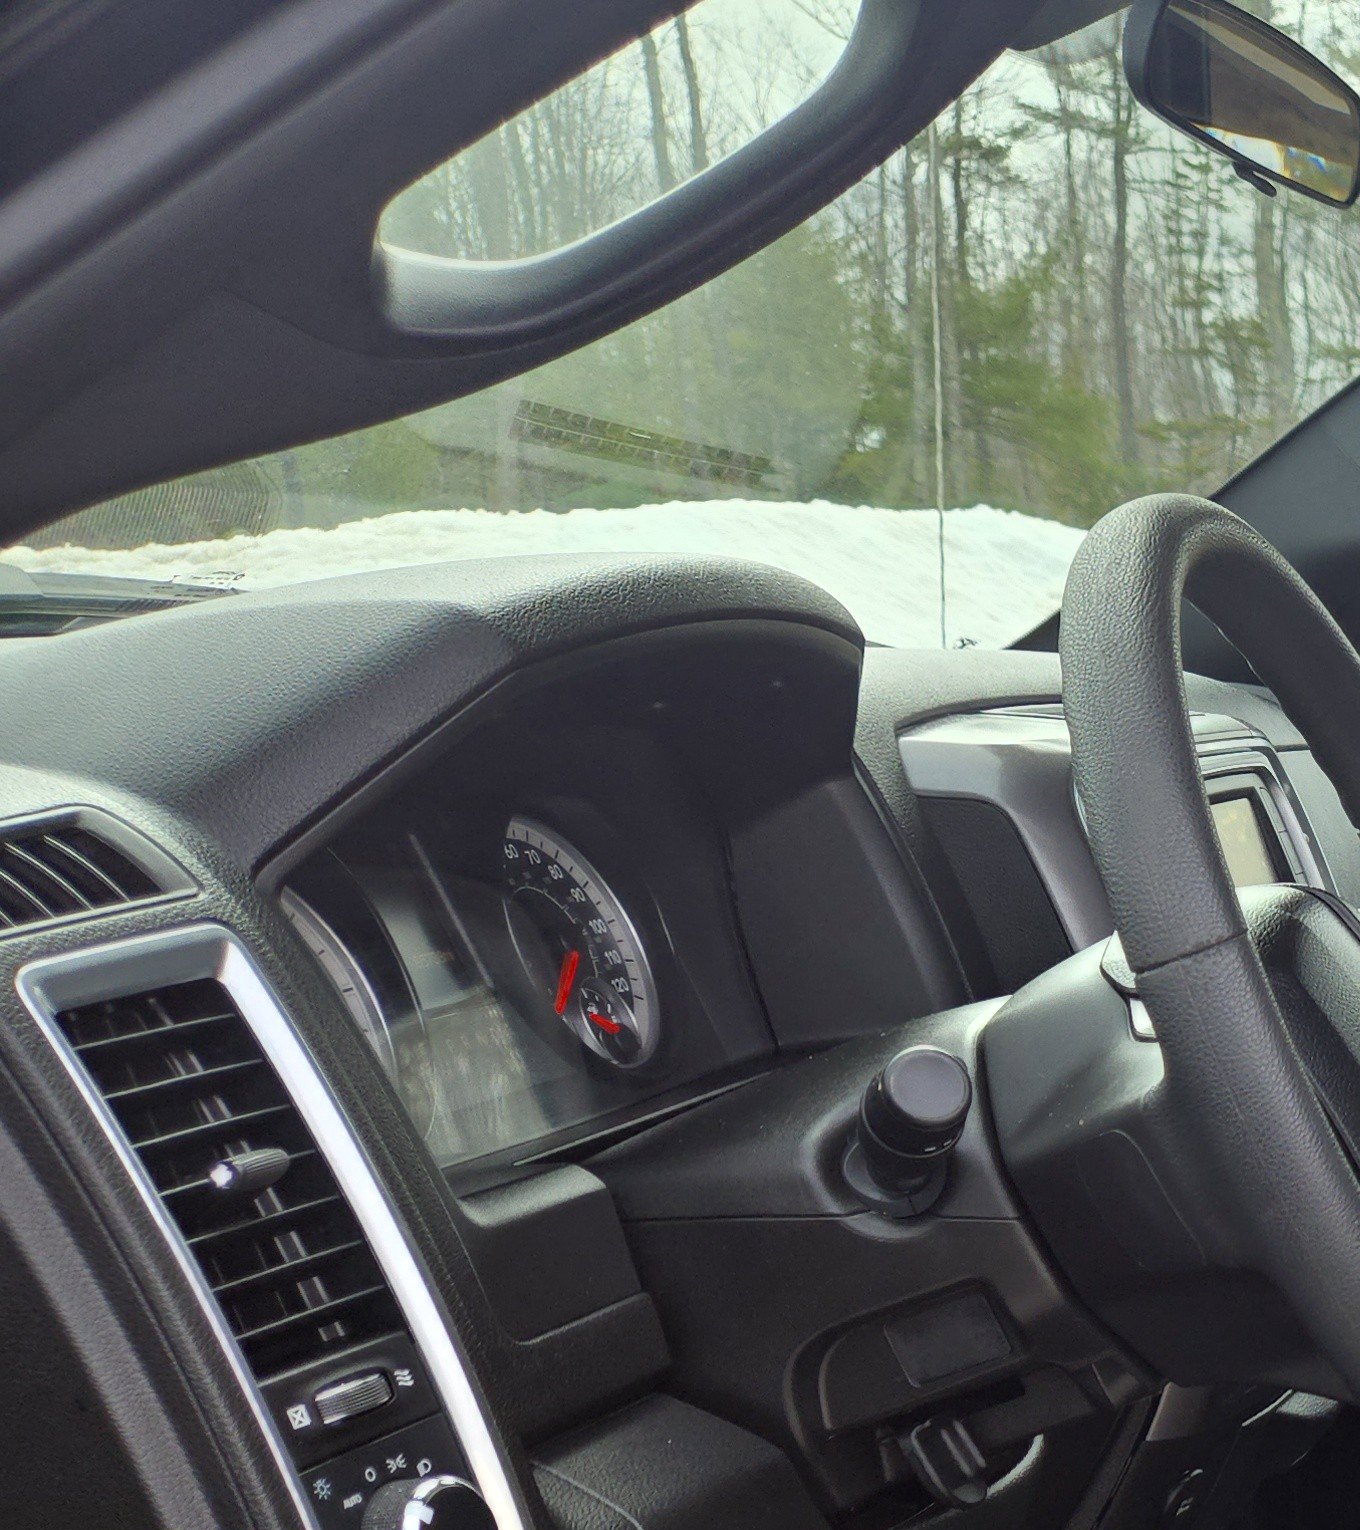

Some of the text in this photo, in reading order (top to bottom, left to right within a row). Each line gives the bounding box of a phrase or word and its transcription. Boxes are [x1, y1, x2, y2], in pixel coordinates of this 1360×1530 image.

[503, 843, 519, 859] 60
[524, 850, 541, 865] 70
[548, 864, 564, 880] 80
[571, 887, 586, 902] 90
[589, 919, 607, 935] 100
[604, 950, 620, 965] 110
[611, 976, 629, 993] 120
[343, 1492, 362, 1509] AUTO
